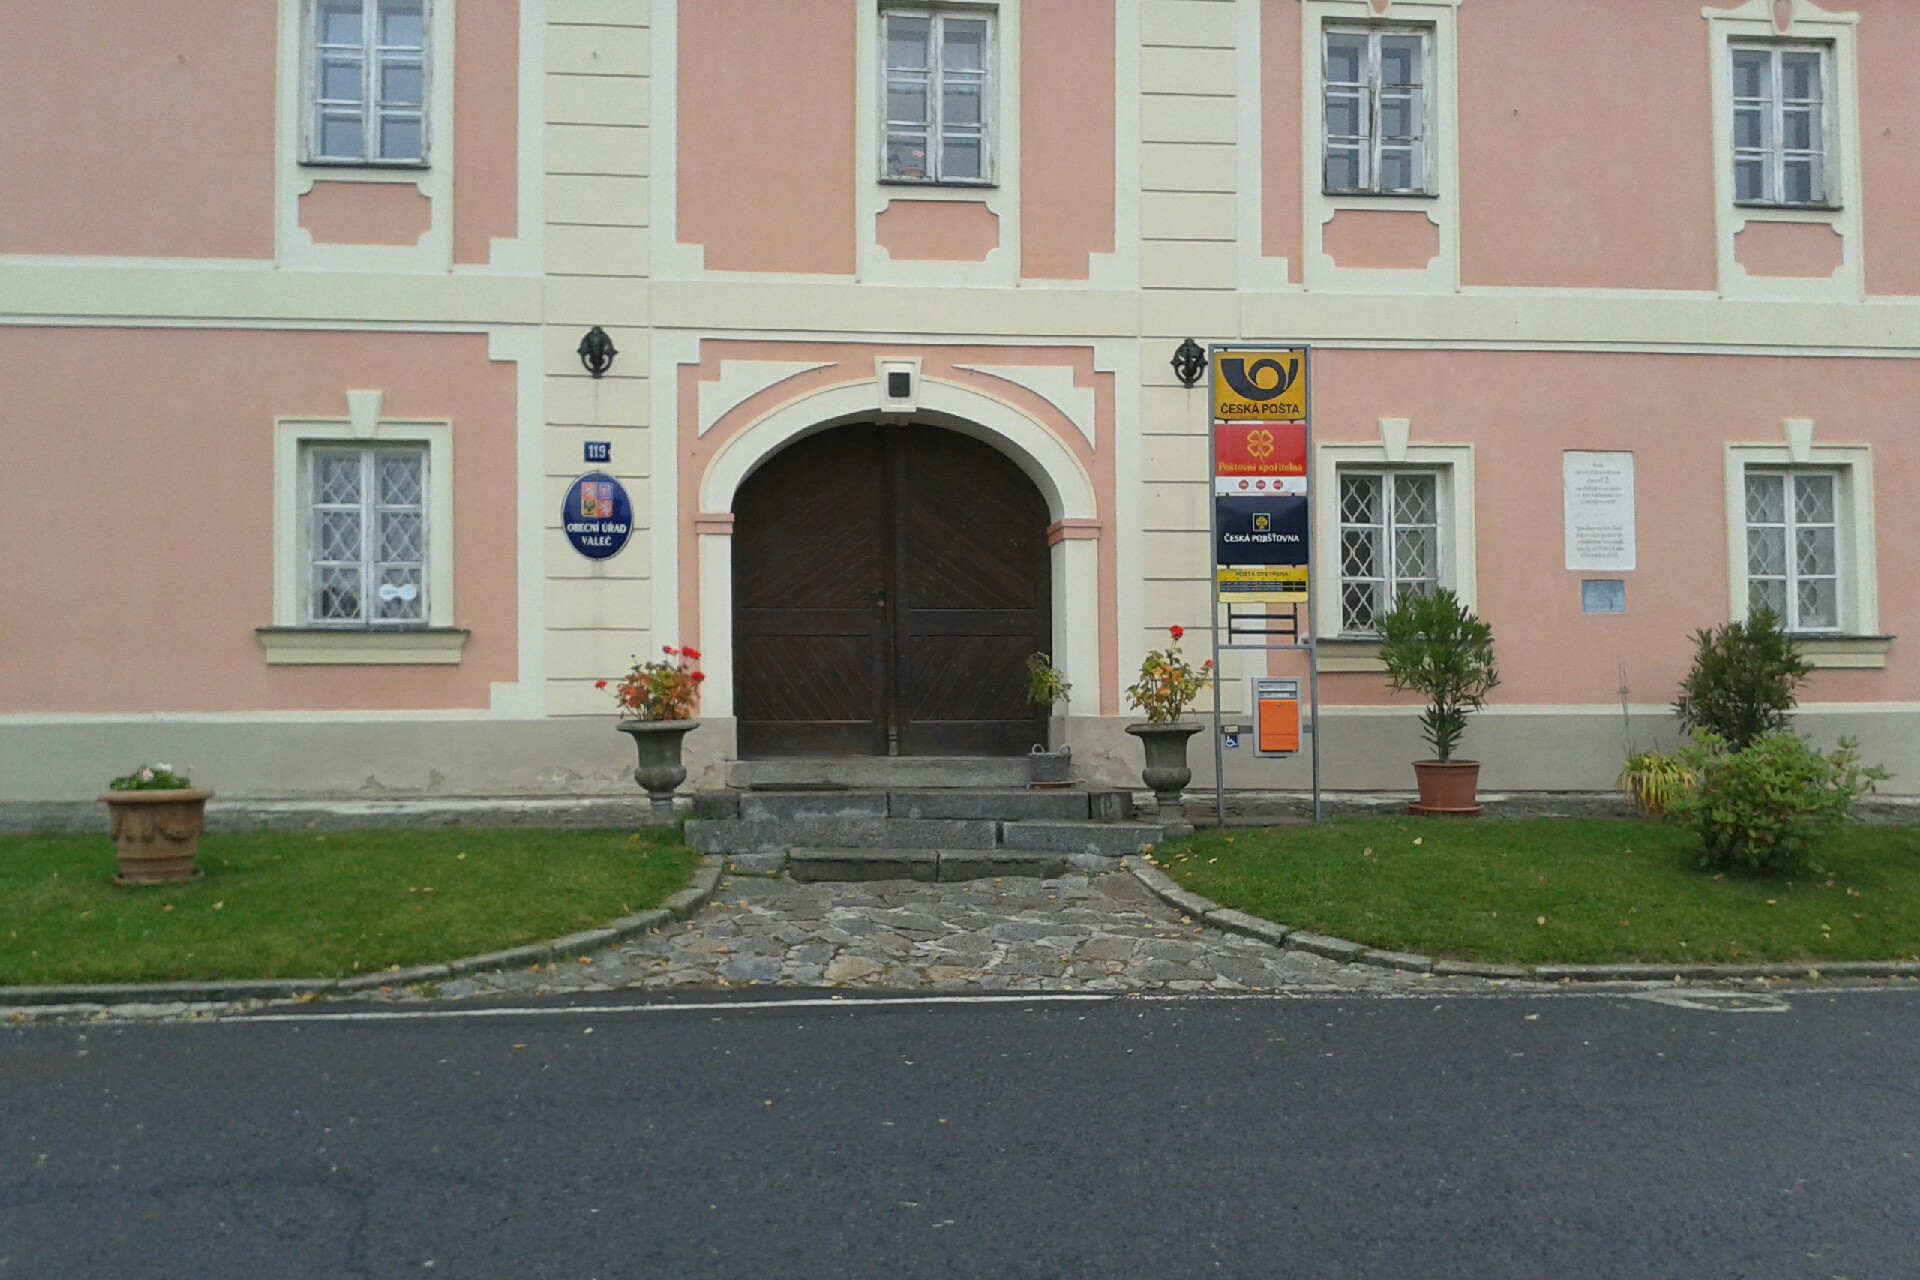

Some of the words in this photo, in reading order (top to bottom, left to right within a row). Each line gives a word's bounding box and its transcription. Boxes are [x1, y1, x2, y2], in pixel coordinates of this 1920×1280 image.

[1220, 402, 1259, 414] ČESKÁ
[1261, 402, 1300, 414] POŠTA
[587, 445, 606, 459] 119
[1218, 461, 1256, 471] Poštovní
[1258, 462, 1303, 473] spořitelna
[567, 521, 600, 532] OBECNÍ
[601, 521, 627, 533] ÚŘAD
[1223, 532, 1251, 543] ČESKÁ
